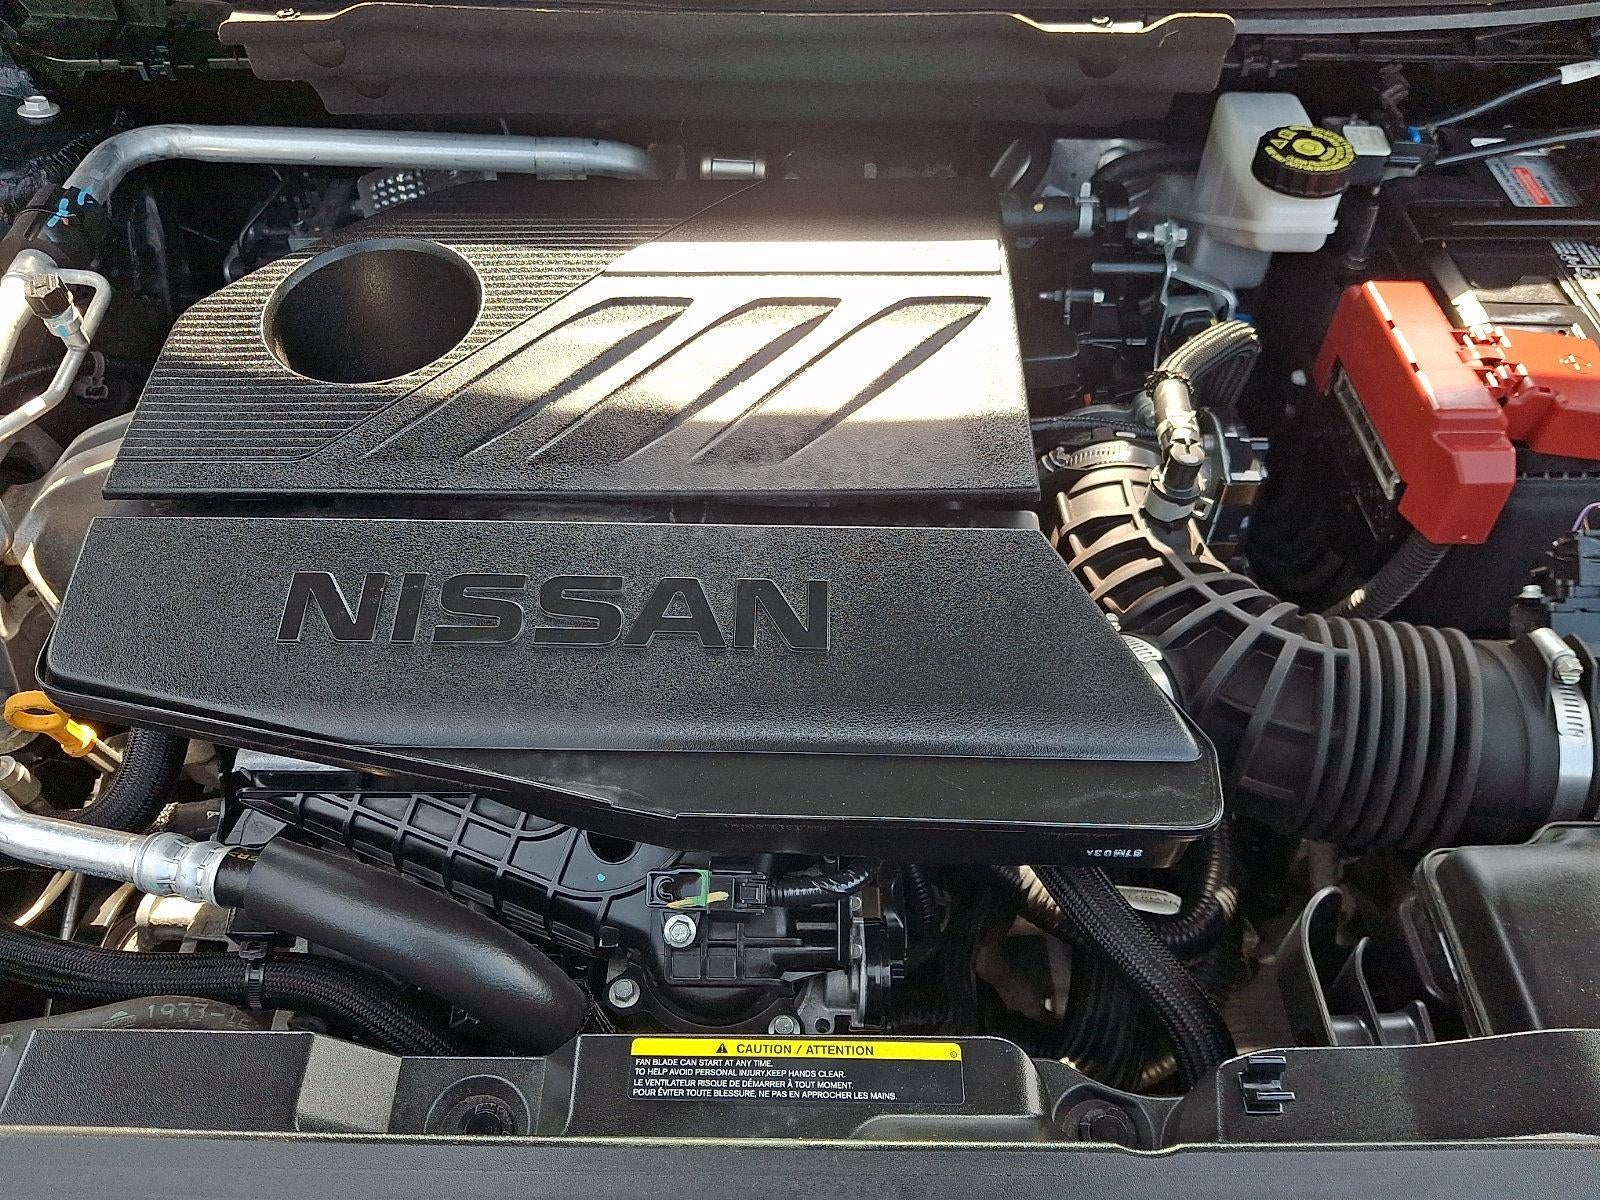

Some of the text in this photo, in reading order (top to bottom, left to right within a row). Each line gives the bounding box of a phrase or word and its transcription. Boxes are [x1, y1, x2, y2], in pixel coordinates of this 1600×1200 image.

[276, 571, 831, 651] NISSAN
[736, 1043, 874, 1056] CAUTION / ATTENTION
[635, 1058, 651, 1066] FAN
[680, 1059, 697, 1067] CAN
[698, 1059, 723, 1067] START
[752, 1060, 774, 1068] TIME.
[635, 1068, 646, 1076] TO
[647, 1068, 668, 1076] HELP
[694, 1069, 737, 1077] PERSONAL
[788, 1070, 816, 1078] HANDS
[817, 1070, 846, 1078] CLEAR.
[633, 1078, 854, 1090] LE VENTILATEUR RISQUE DE DÉMARRER À TOUT MOMENT.
[632, 1088, 656, 1096] POUR
[657, 1087, 685, 1096] ÉVITER
[685, 1088, 712, 1097] TOUTE
[713, 1089, 757, 1099] BLESSURE,
[758, 1090, 770, 1098] NE
[771, 1090, 788, 1098] PAS
[788, 1091, 800, 1099] EN
[801, 1091, 852, 1099] APPROCHER
[870, 1092, 898, 1100] MAINS.
